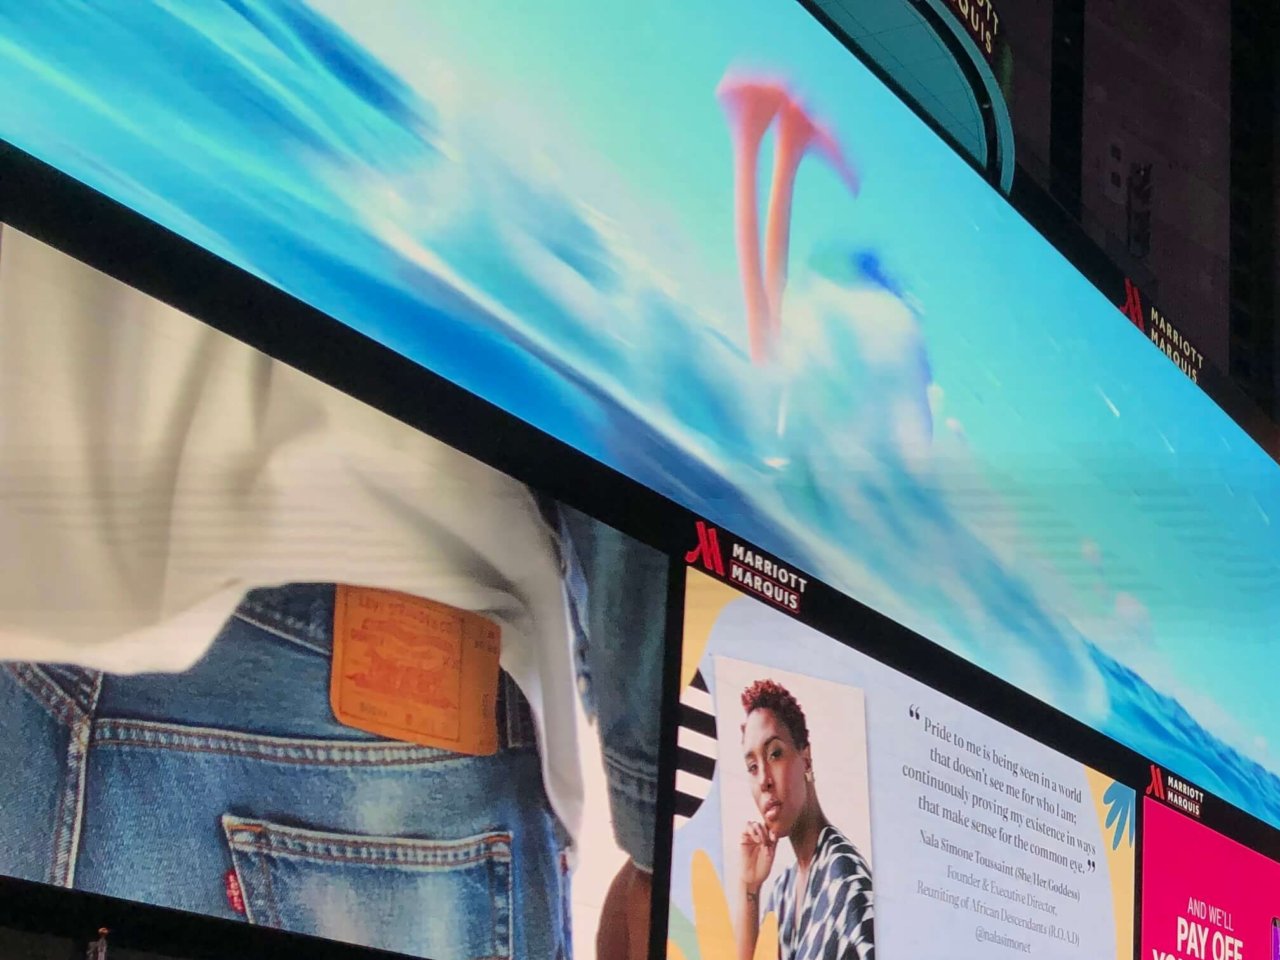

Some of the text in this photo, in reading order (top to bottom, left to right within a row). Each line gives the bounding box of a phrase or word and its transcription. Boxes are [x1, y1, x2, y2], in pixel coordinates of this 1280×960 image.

[958, 0, 991, 54] QUIS
[1150, 306, 1204, 369] MARRIOTT
[1150, 327, 1198, 384] MARQUIS
[731, 565, 799, 610] MARQUIS
[732, 543, 808, 593] MARRIOTT
[924, 716, 952, 743] Pride
[953, 732, 964, 748] to
[966, 740, 981, 754] me
[983, 744, 991, 760] is
[993, 749, 1019, 776] being
[1020, 765, 1040, 784] seen
[1041, 772, 1050, 789] in
[1051, 779, 1057, 792] a
[1058, 781, 1082, 804] world
[902, 763, 1096, 856] continuously proving my existence in ways
[930, 748, 951, 769] that
[953, 757, 987, 786] doesn't
[989, 775, 1004, 793] see
[1006, 782, 1020, 799] me
[1021, 787, 1035, 806] for
[1036, 793, 1055, 815] who
[1061, 807, 1078, 825] am;
[1166, 776, 1204, 803] MARRIOTT
[1166, 791, 1200, 816] MARQUIS
[918, 795, 940, 817] that
[942, 803, 970, 829] make
[971, 818, 997, 840] sense
[998, 827, 1012, 848] for
[1013, 834, 1029, 853] the
[1030, 842, 1069, 868] common
[1070, 856, 1086, 876] eye.
[920, 829, 940, 850] Nala
[941, 837, 974, 863] Simone
[975, 847, 1014, 877] Toussaint
[917, 880, 960, 910] Reuniting
[960, 893, 970, 910] of
[970, 899, 1000, 920] African
[1000, 907, 1047, 936] Descendants
[947, 865, 981, 891] Founder
[990, 880, 1026, 906] Executive
[1176, 916, 1210, 960] PAY
[1187, 897, 1234, 932] AND WE'LL
